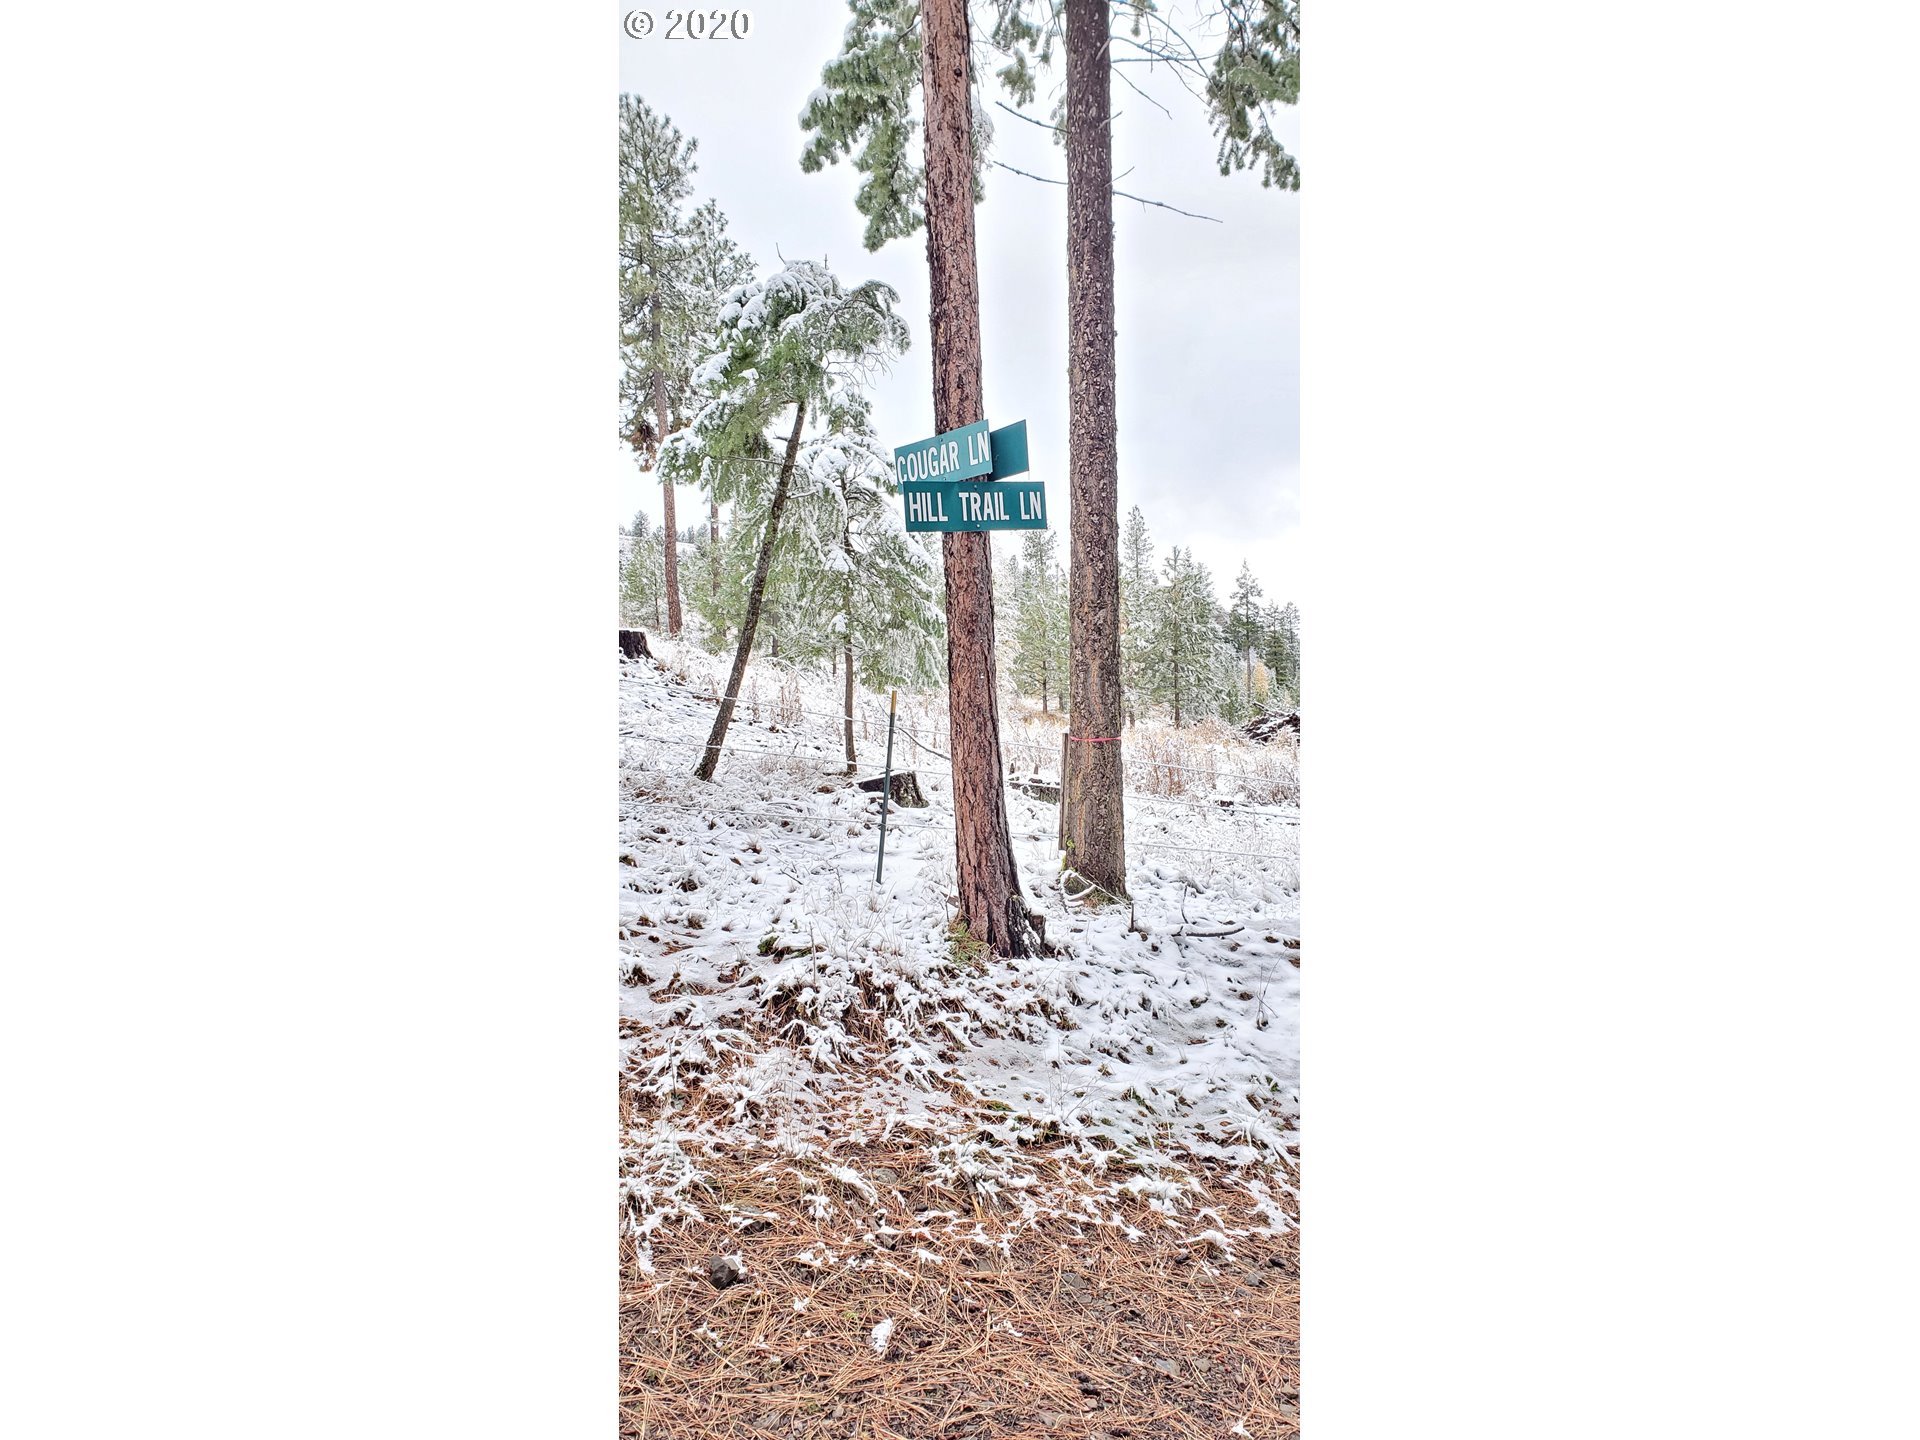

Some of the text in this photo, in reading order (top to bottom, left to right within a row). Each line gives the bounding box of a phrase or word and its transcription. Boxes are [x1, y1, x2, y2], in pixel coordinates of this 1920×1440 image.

[896, 430, 990, 484] COUGAR LN
[908, 491, 1042, 522] HILL TRAIL LN
